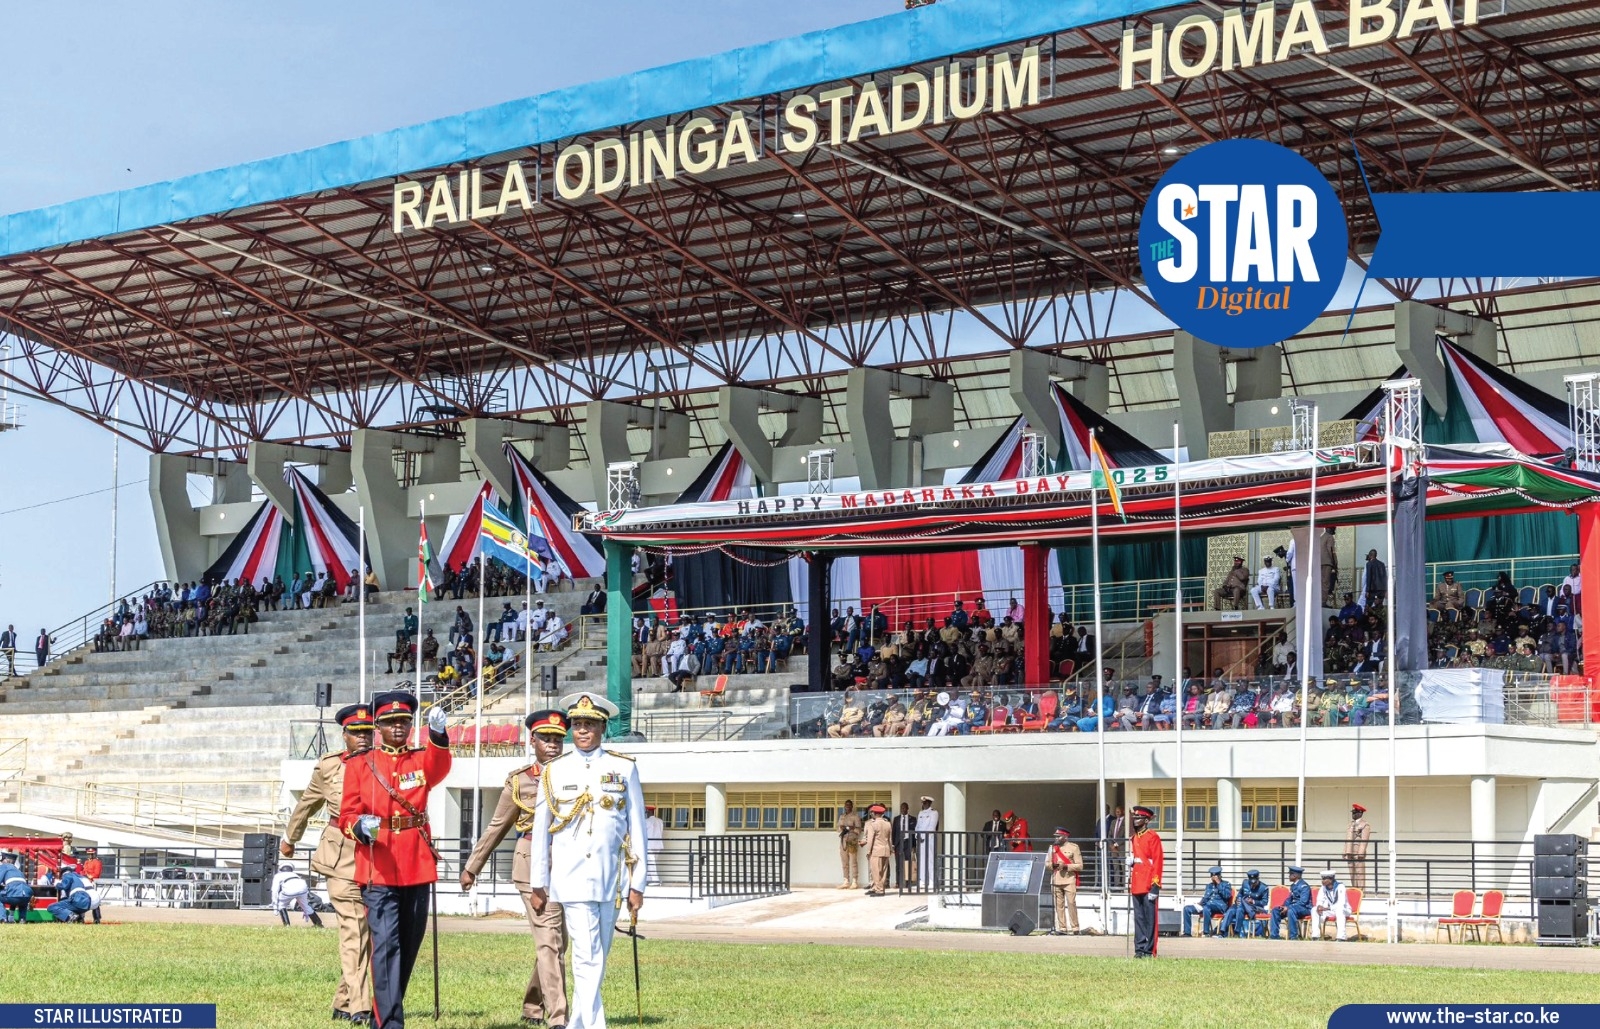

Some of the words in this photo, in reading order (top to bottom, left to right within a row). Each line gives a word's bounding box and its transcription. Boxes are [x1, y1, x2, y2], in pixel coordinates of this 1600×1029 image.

[394, 161, 534, 233] RAILA
[555, 110, 759, 200] ODINGA
[782, 45, 1042, 152] STADIUM
[1119, 0, 1330, 91] HOMA
[738, 496, 822, 514] HAPPY
[841, 484, 995, 508] MADARAKA
[1016, 475, 1070, 495] DAY
[1093, 465, 1168, 486] 025
